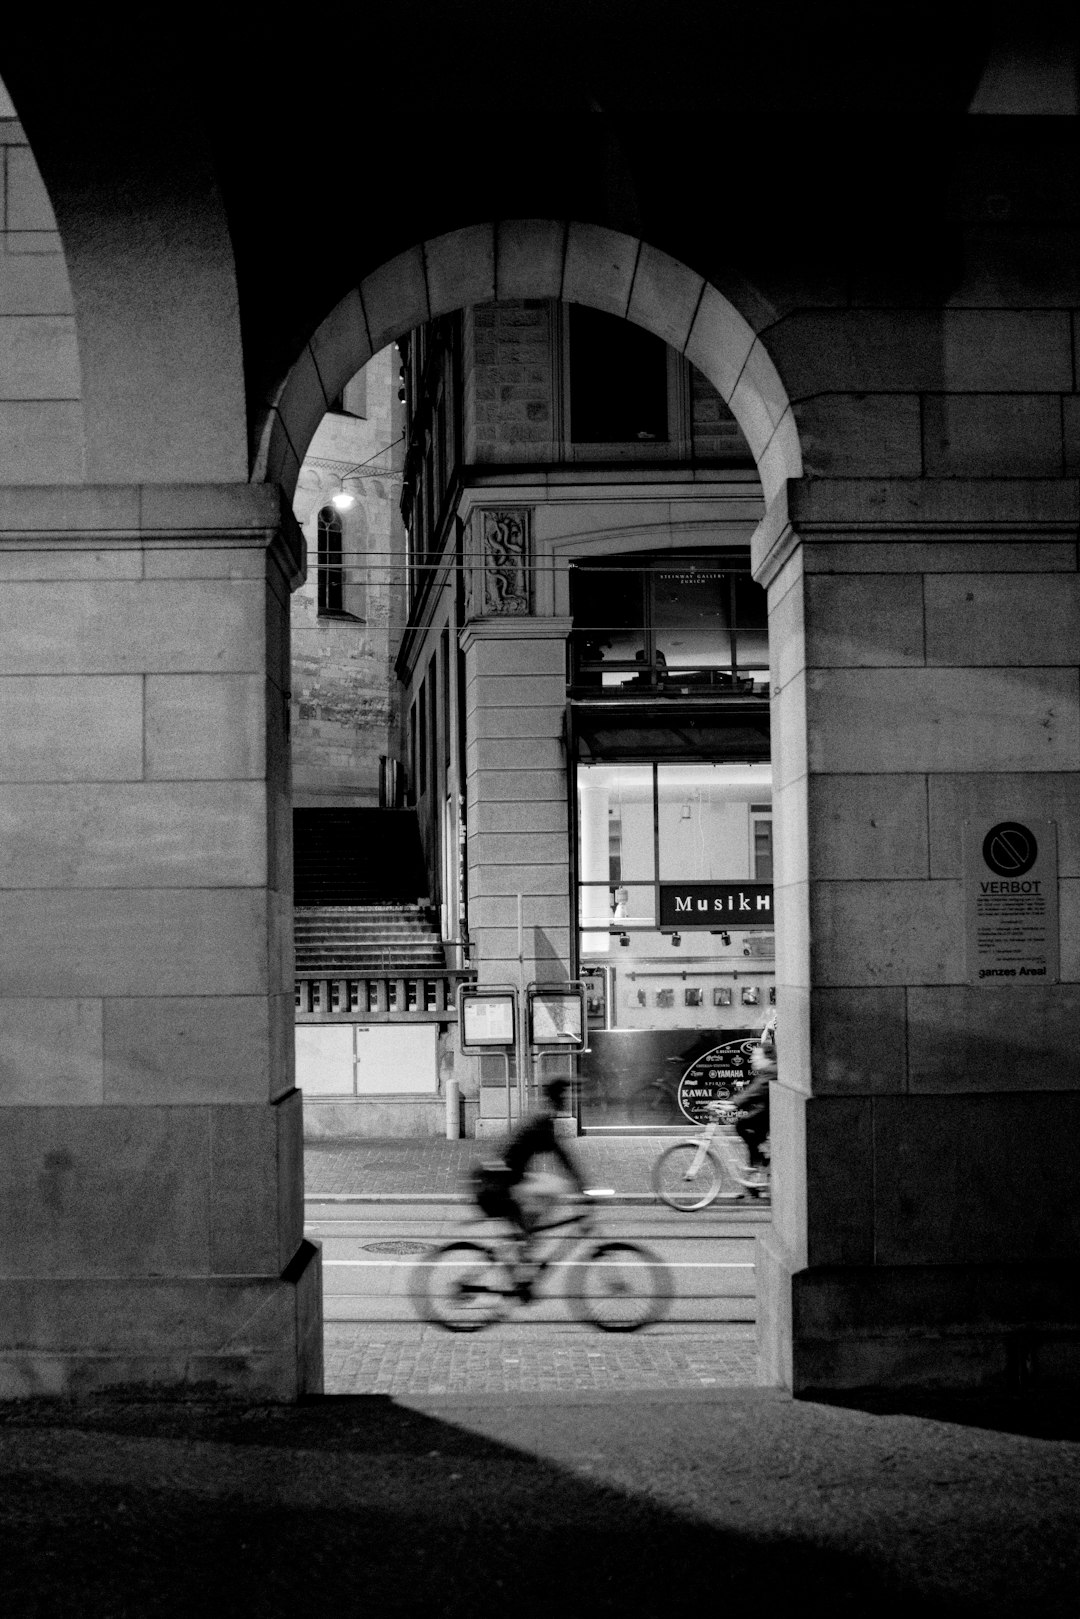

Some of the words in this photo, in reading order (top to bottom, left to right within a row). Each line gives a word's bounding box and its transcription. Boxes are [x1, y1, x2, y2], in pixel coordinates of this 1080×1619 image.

[980, 881, 1041, 893] VERBOT
[978, 968, 1017, 979] ganzes
[1019, 966, 1047, 976] Areal
[717, 1069, 744, 1078] YAMAHA
[682, 1089, 712, 1098] KAWAI
